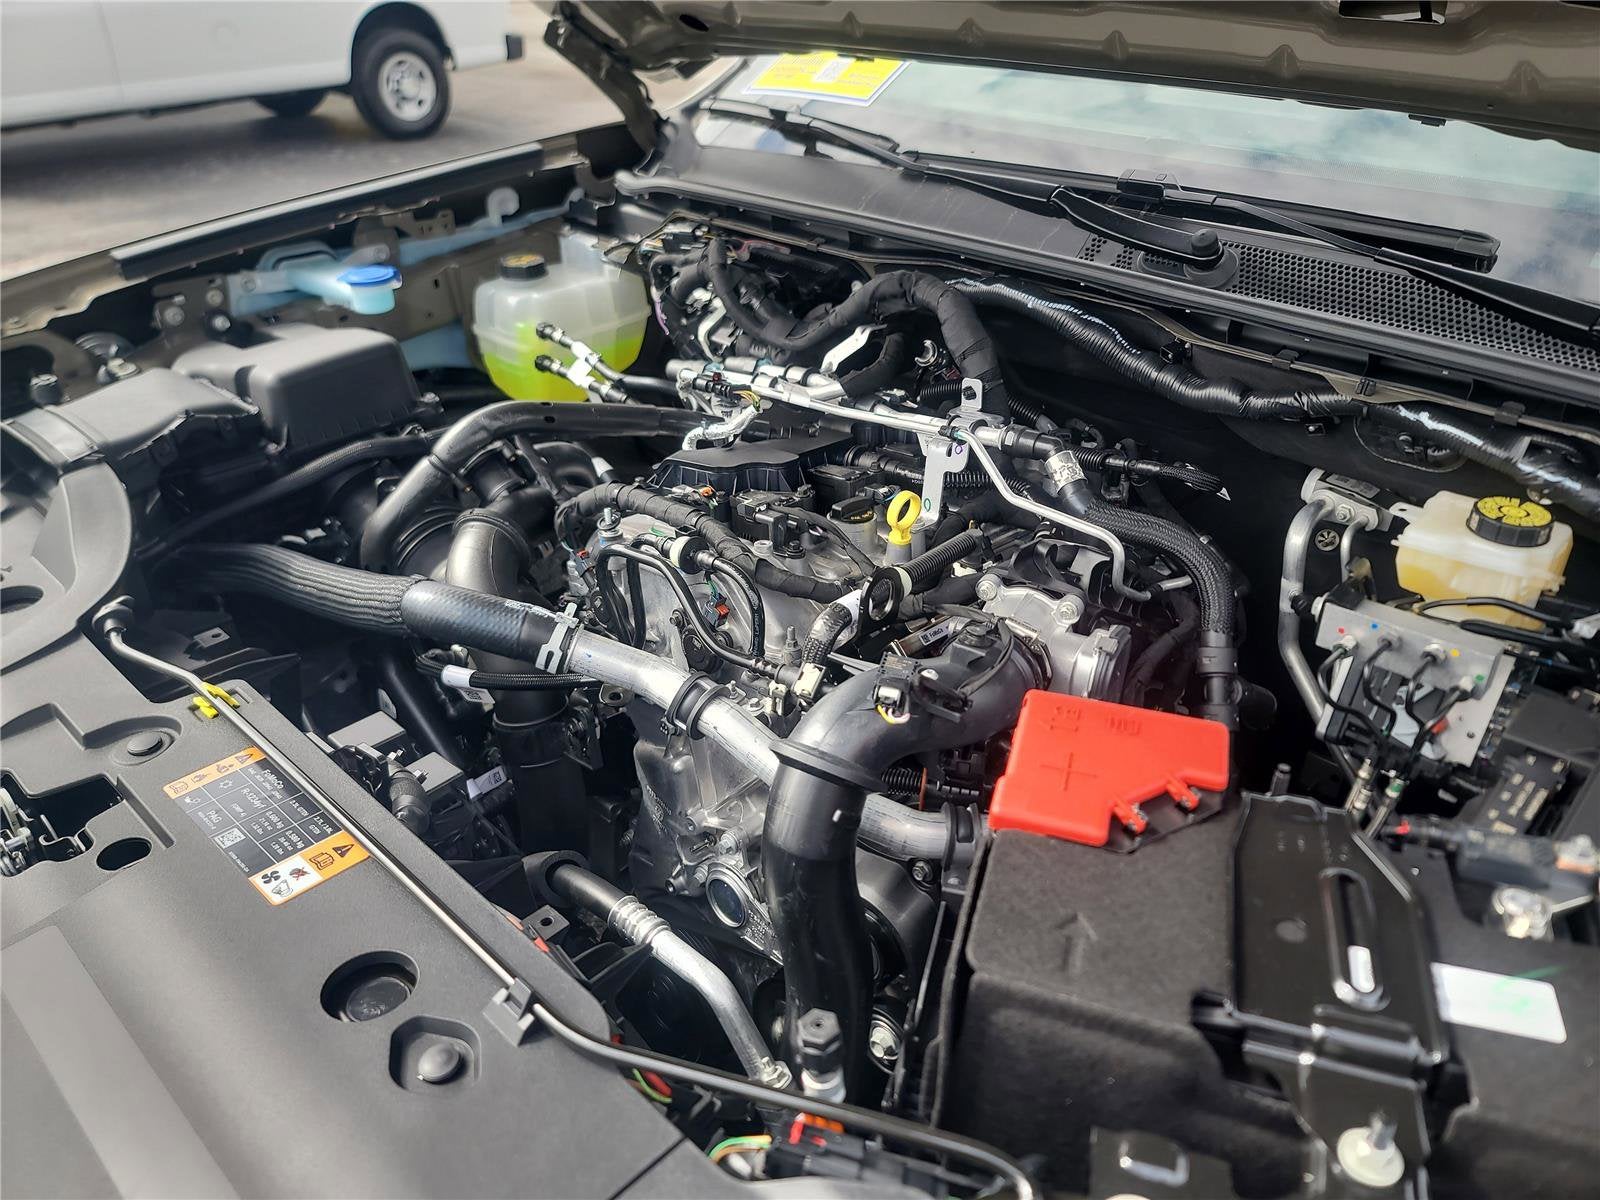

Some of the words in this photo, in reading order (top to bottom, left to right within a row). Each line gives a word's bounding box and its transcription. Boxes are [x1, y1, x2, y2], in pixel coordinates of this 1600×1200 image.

[261, 768, 286, 789] FoMoCo
[240, 787, 267, 810] R-1234yf
[205, 809, 223, 823] PAG
